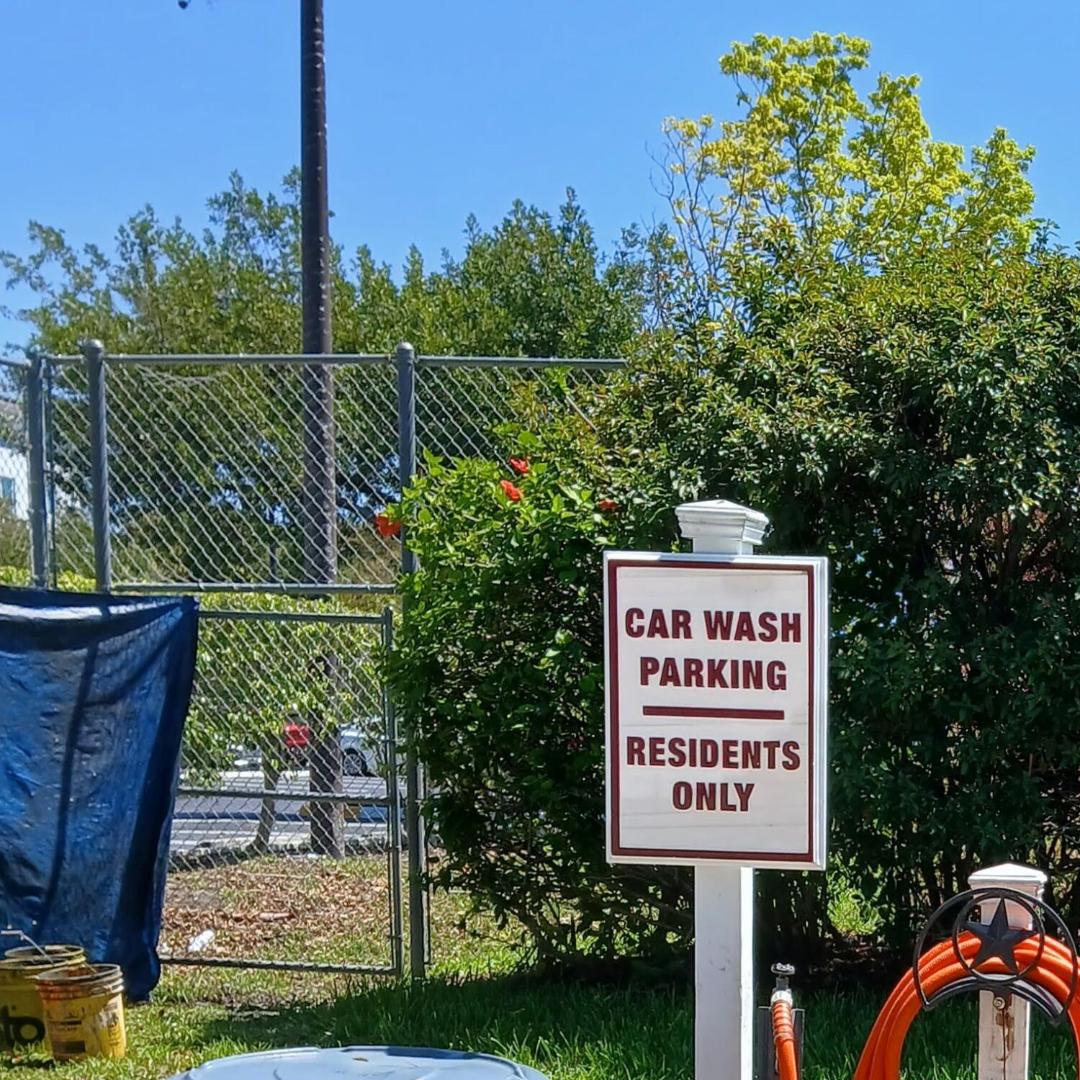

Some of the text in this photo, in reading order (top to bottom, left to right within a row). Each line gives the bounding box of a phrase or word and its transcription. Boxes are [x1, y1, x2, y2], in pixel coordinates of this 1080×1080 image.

[625, 607, 801, 643] CAR WASH
[640, 656, 787, 691] PARKING
[627, 736, 801, 771] RESIDENTS
[672, 780, 754, 812] ONLY
